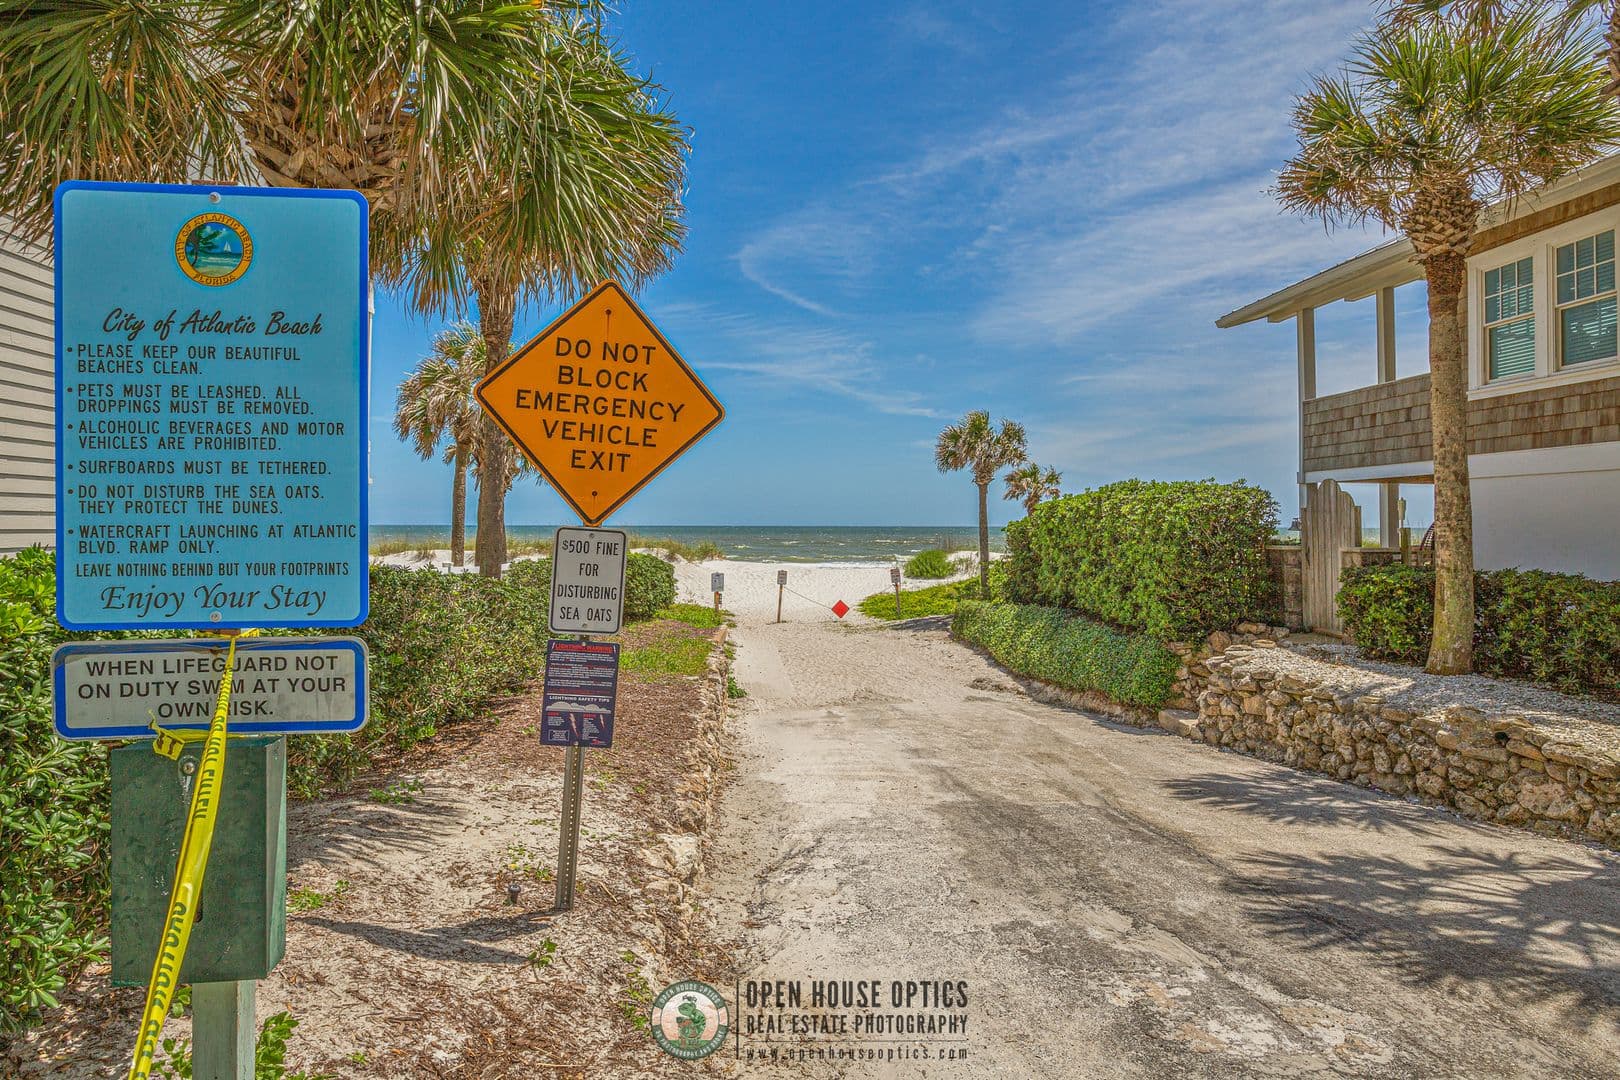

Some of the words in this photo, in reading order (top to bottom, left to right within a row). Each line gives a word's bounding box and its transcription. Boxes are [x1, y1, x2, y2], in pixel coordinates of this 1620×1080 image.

[193, 273, 236, 286] FLORIDA
[103, 308, 145, 341] City
[154, 310, 176, 341] of
[180, 310, 255, 335] Atlantic
[265, 311, 322, 335] Beach
[78, 344, 133, 358] PLEASE
[143, 345, 178, 358] KEEP
[188, 346, 215, 359] OUR
[226, 347, 300, 360] BEAUTIFUL
[556, 337, 591, 358] DO
[602, 342, 656, 365] NOT
[78, 360, 143, 373] BEACHES
[154, 361, 202, 374] CLEAN.
[558, 365, 648, 392] BLOCK
[78, 384, 113, 397] PETS
[124, 384, 161, 397] MUST
[172, 385, 188, 398] BE
[199, 385, 265, 399] LEASHED.
[276, 386, 300, 399] ALL
[79, 399, 160, 413] DROPPINGS
[170, 401, 208, 413] MUST
[218, 401, 234, 414] BE
[244, 401, 313, 414] REMOVED.
[516, 389, 685, 422] EMERGENCY
[79, 421, 159, 434] ALCOHOLIC
[170, 421, 251, 434] BEVERAGES
[262, 422, 288, 435] AND
[298, 422, 344, 435] MOTOR
[543, 419, 657, 447] VEHICLE
[79, 436, 147, 449] VEHICLES
[158, 437, 185, 449] ARE
[195, 437, 280, 450] PROHIBITED.
[79, 461, 174, 473] SURFBOARDS
[184, 461, 222, 474] MUST
[232, 461, 248, 474] BE
[258, 461, 330, 474] TETHERED.
[571, 450, 630, 472] EXIT
[79, 485, 96, 498] DO
[107, 485, 134, 498] NOT
[145, 485, 204, 498] DISTURB
[214, 486, 239, 498] THE
[250, 485, 275, 498] SEA
[286, 486, 323, 498] OATS.
[79, 501, 114, 513] THEY
[125, 501, 187, 514] PROTECT
[198, 501, 223, 513] THE
[233, 501, 282, 513] DUNES.
[79, 525, 170, 538] WATERCRAFT
[180, 525, 258, 538] LAUNCHING
[268, 525, 283, 537] AT
[294, 525, 355, 537] ATLANTIC
[79, 541, 119, 553] BLVD.
[130, 541, 169, 553] RAMP
[179, 541, 219, 553] ONLY.
[562, 540, 589, 554] $500
[597, 542, 619, 555] FINE
[77, 564, 111, 577] LEAVE
[118, 563, 166, 576] NOTHING
[173, 563, 213, 576] BEHIND
[219, 563, 239, 576] BUT
[246, 563, 276, 576] YOUR
[282, 563, 348, 575] FOOTPRINTS
[580, 563, 598, 576] FOR
[558, 584, 617, 600] DISTURBING
[101, 585, 184, 617] Enjoy
[194, 583, 260, 608] Your
[264, 585, 326, 615] Stay
[560, 607, 579, 620] SEA
[587, 608, 611, 621] OATS
[86, 660, 153, 676] WHEN
[296, 656, 338, 670] NOT
[79, 684, 110, 699] ON
[120, 681, 179, 697] DUTY
[187, 677, 240, 694] SWM
[253, 679, 279, 693] AT
[287, 678, 345, 692] YOUR
[158, 701, 210, 717] OWN
[223, 699, 273, 716] ISK.
